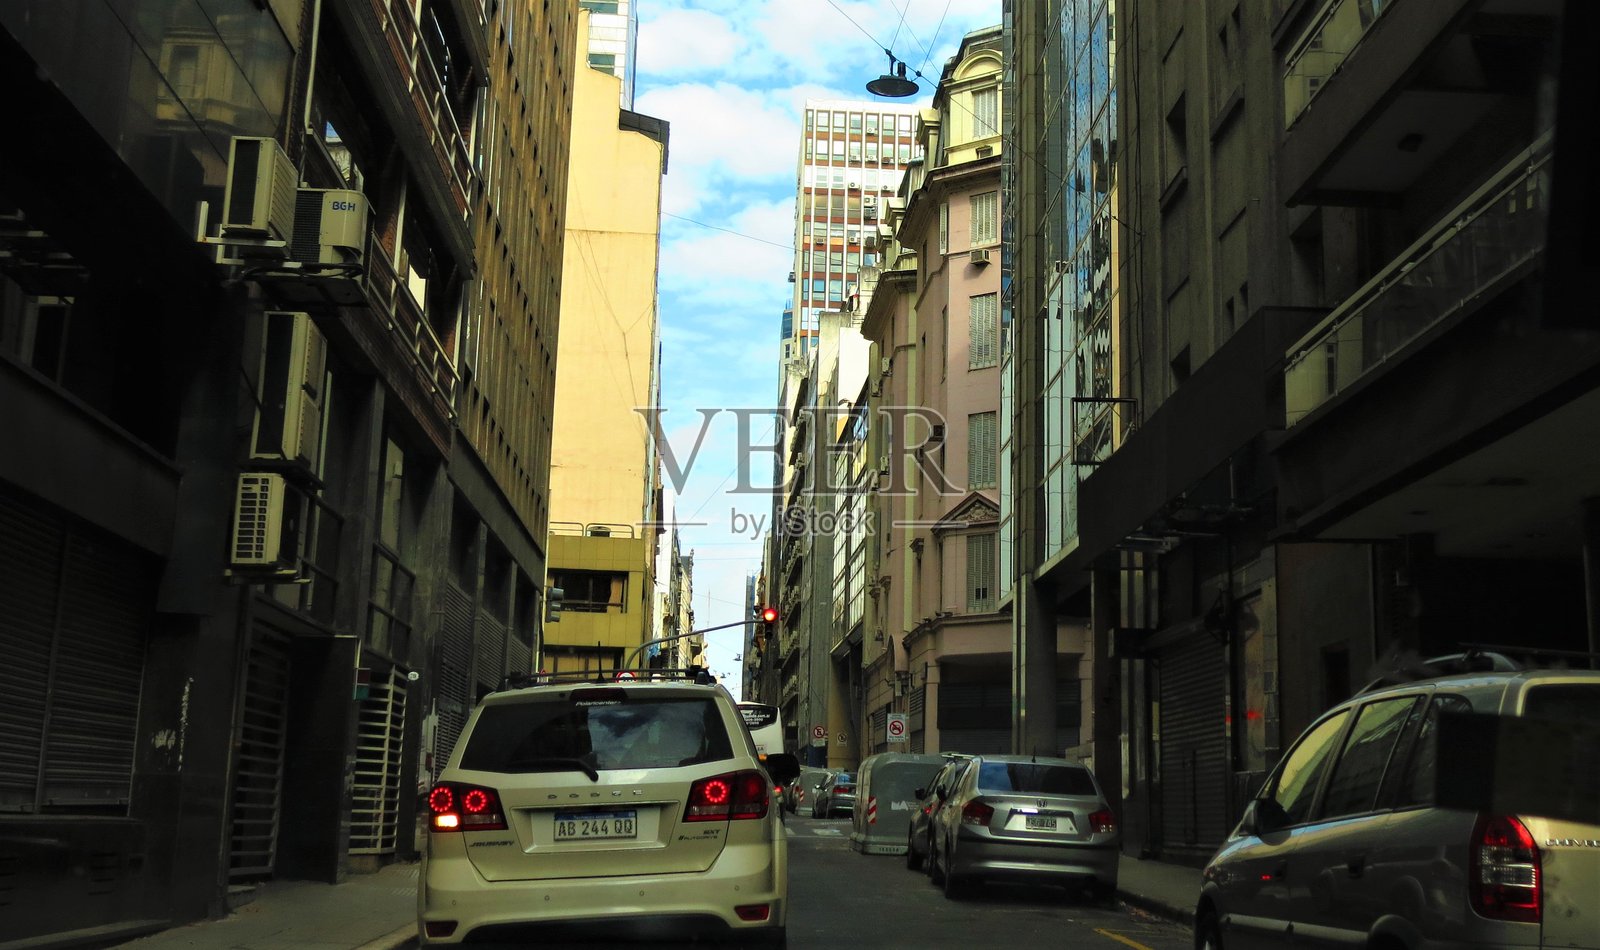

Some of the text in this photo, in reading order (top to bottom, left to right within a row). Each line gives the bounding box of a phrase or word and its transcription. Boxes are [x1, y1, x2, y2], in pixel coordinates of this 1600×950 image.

[332, 201, 356, 212] BGH
[558, 821, 576, 837] AB
[581, 820, 608, 836] 244
